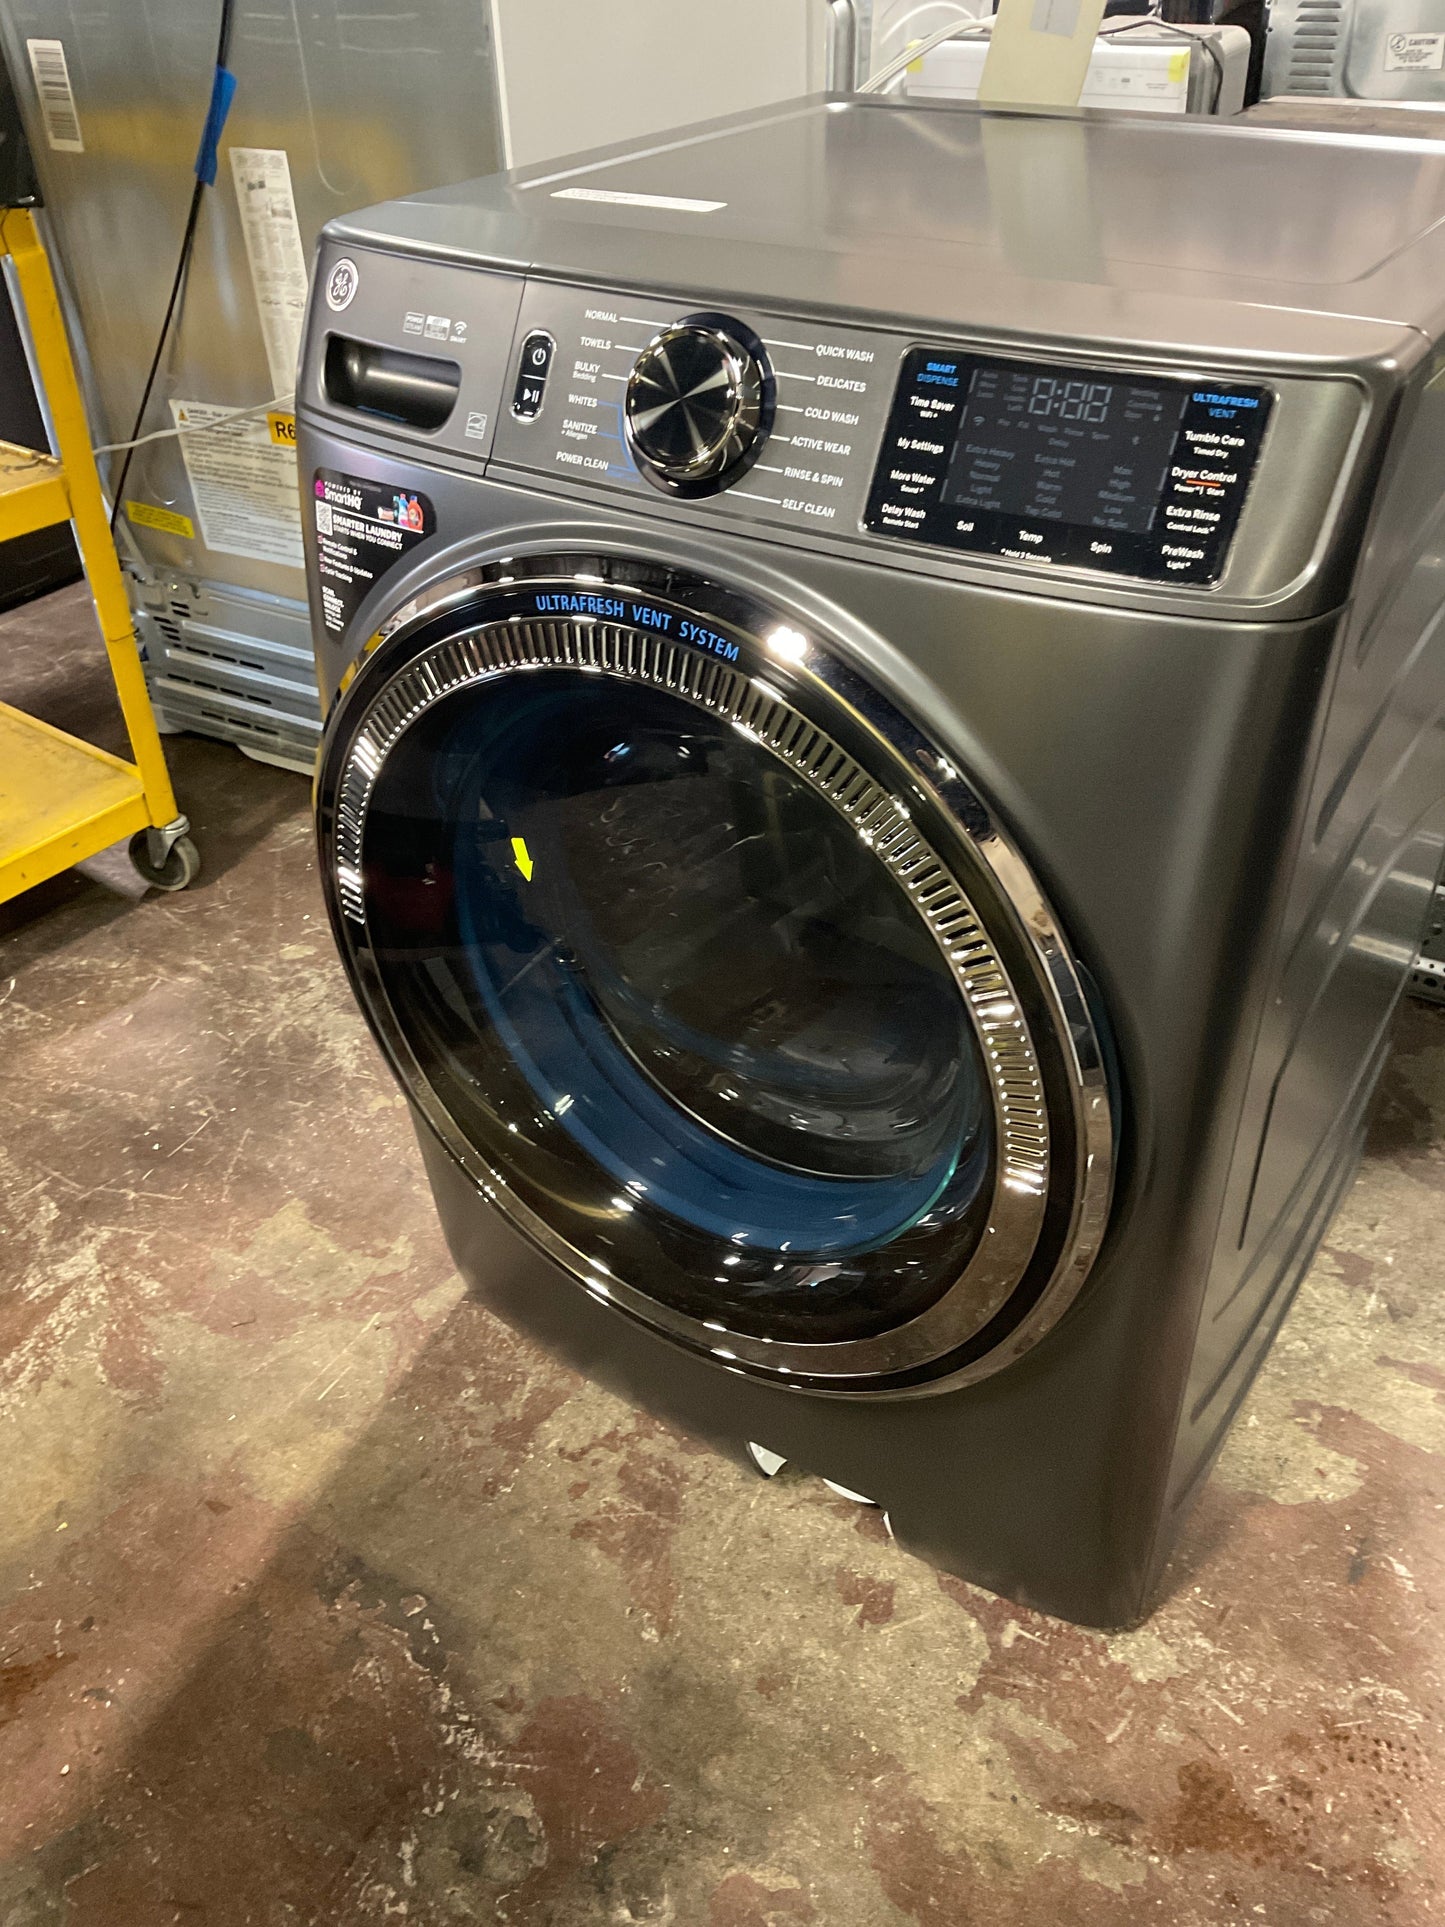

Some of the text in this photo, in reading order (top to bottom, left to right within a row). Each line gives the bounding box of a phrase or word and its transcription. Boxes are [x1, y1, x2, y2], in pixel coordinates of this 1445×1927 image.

[584, 310, 618, 322] NORMAL
[580, 336, 612, 350] TOWELS
[816, 344, 874, 362] QUICK WASH
[575, 361, 600, 373] BULKY
[926, 362, 957, 374] SMART
[816, 375, 866, 392] DELICATES
[917, 373, 959, 387] DISPENSE
[568, 394, 598, 408] WHITES
[910, 396, 955, 412] Time Saver
[1192, 392, 1259, 408] ULTRAFRESH
[804, 407, 859, 425] COLD WASH
[1208, 408, 1237, 418] VENT
[563, 419, 598, 434] SANITIZE
[790, 436, 851, 455] ACTIVE WEAR
[897, 437, 944, 454] My Settings
[1185, 430, 1245, 446] Tumble Care
[556, 451, 608, 470] POWER CLEAN
[784, 467, 843, 487] RINSE & SPIN
[890, 470, 936, 485] More Water
[1172, 466, 1237, 483] Dryer Control
[324, 481, 350, 493] POWERED
[325, 488, 361, 510] SmartHQ
[782, 499, 835, 518] SELF CLEAN
[882, 503, 926, 519] Delay Wash
[1166, 506, 1220, 521] Extra Rinse
[333, 514, 403, 542] SMARTER LAUNDRY
[956, 521, 974, 531] Soil
[366, 533, 377, 543] YOU
[1019, 530, 1043, 544] Temp
[1090, 542, 1112, 554] Spin
[1161, 545, 1204, 559] PreWash
[536, 595, 740, 662] ULTRAFRESH VENT SYSTEM
